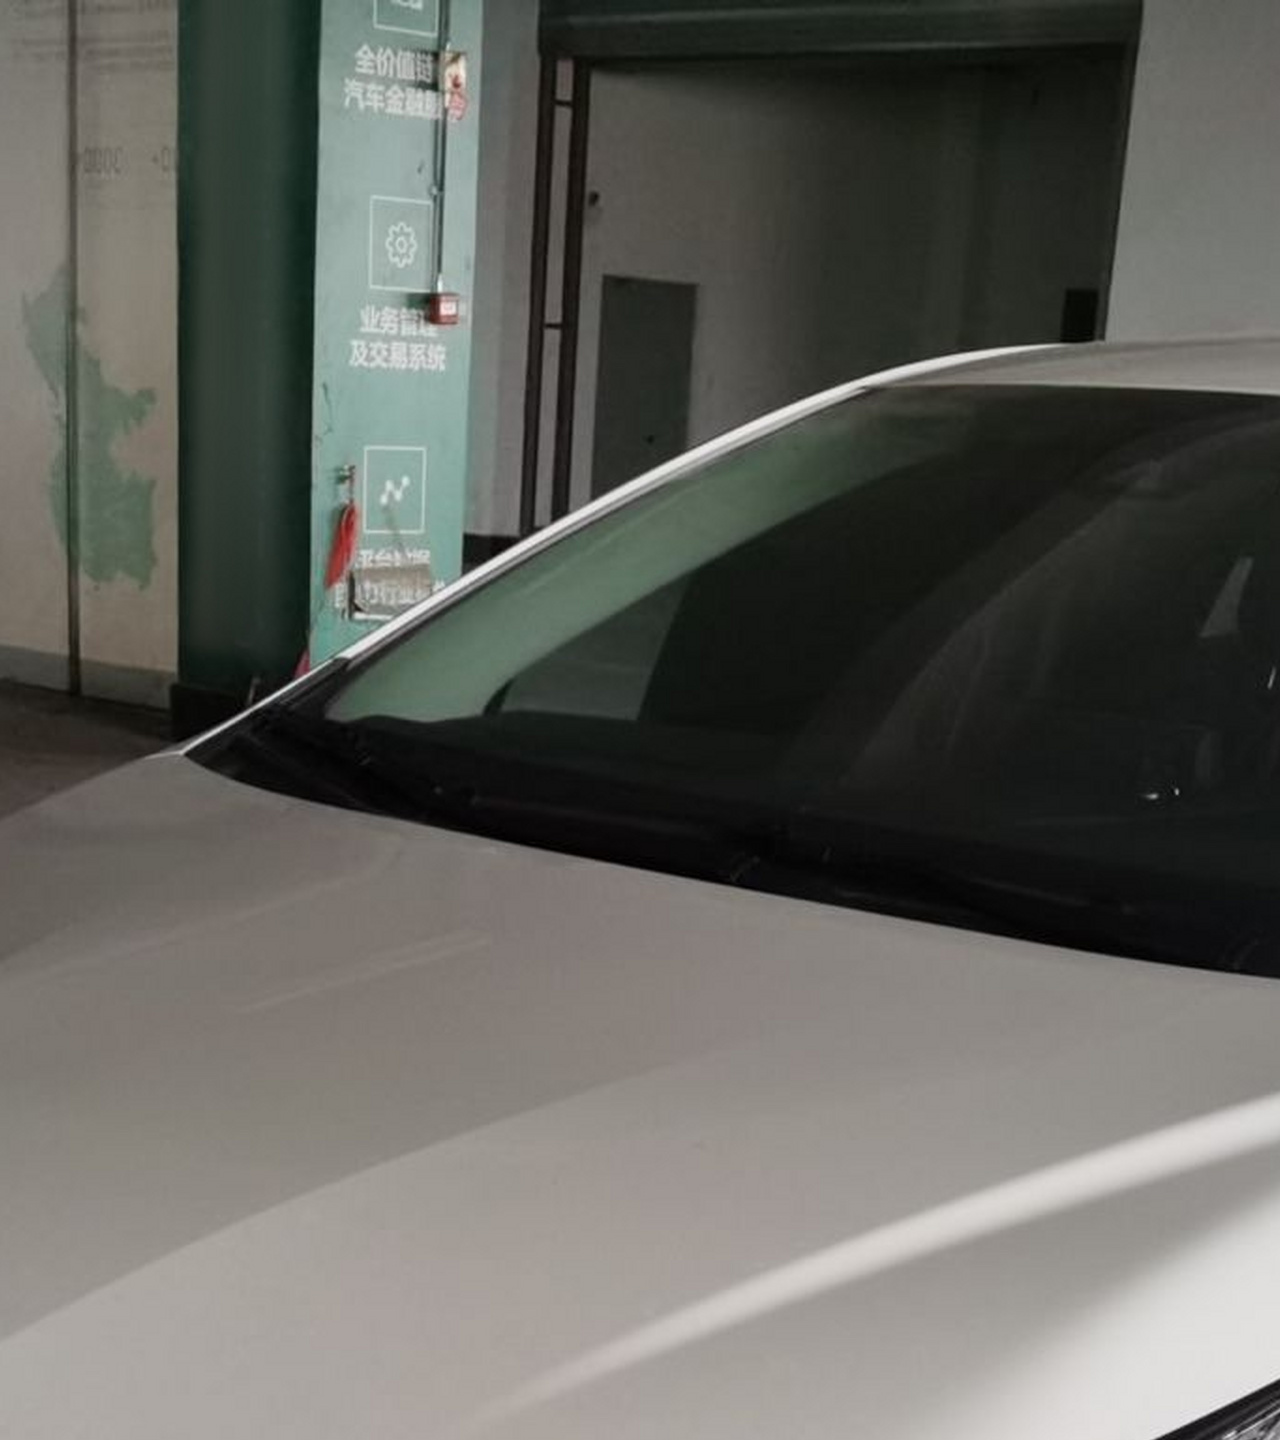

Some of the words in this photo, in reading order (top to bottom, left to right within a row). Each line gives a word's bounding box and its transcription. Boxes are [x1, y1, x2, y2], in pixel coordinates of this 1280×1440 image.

[349, 338, 446, 371] 及交易系统
